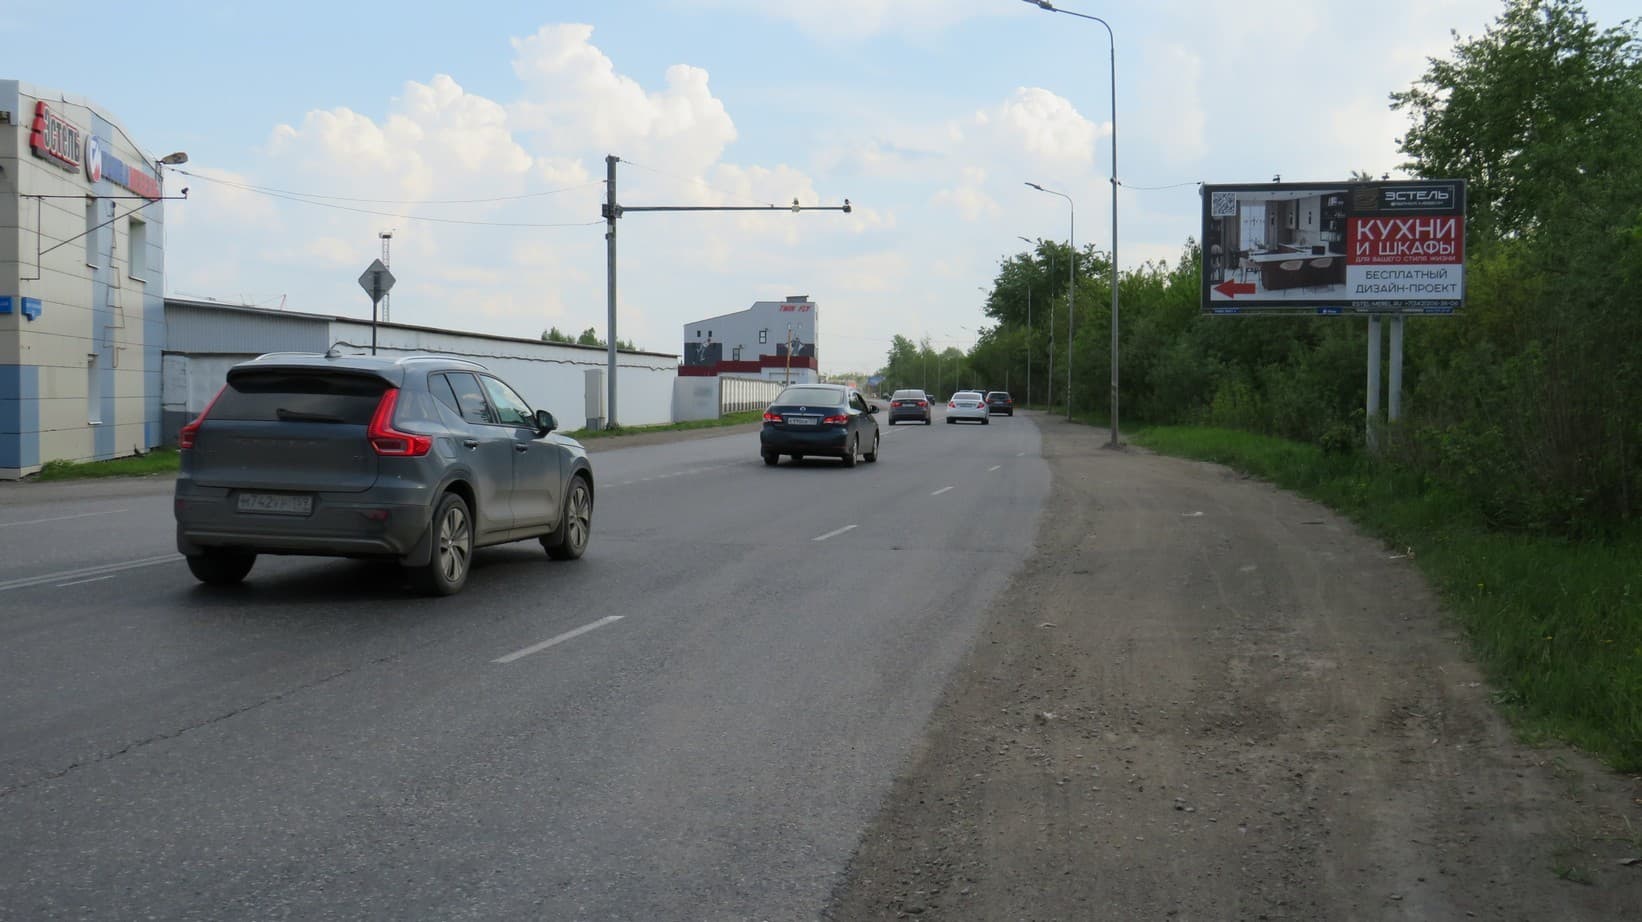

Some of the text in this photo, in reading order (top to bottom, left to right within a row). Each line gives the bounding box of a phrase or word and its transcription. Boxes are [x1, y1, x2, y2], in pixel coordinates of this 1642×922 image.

[1385, 191, 1449, 201] ЭСТЕЛЬ
[1357, 219, 1456, 240] КУХНИ
[1356, 241, 1455, 255] И ШКАФЫ
[1365, 269, 1448, 280] БЕСПЛАТНЫЙ
[1356, 283, 1456, 294] ДИЗАЙН-ПРОЕКТ
